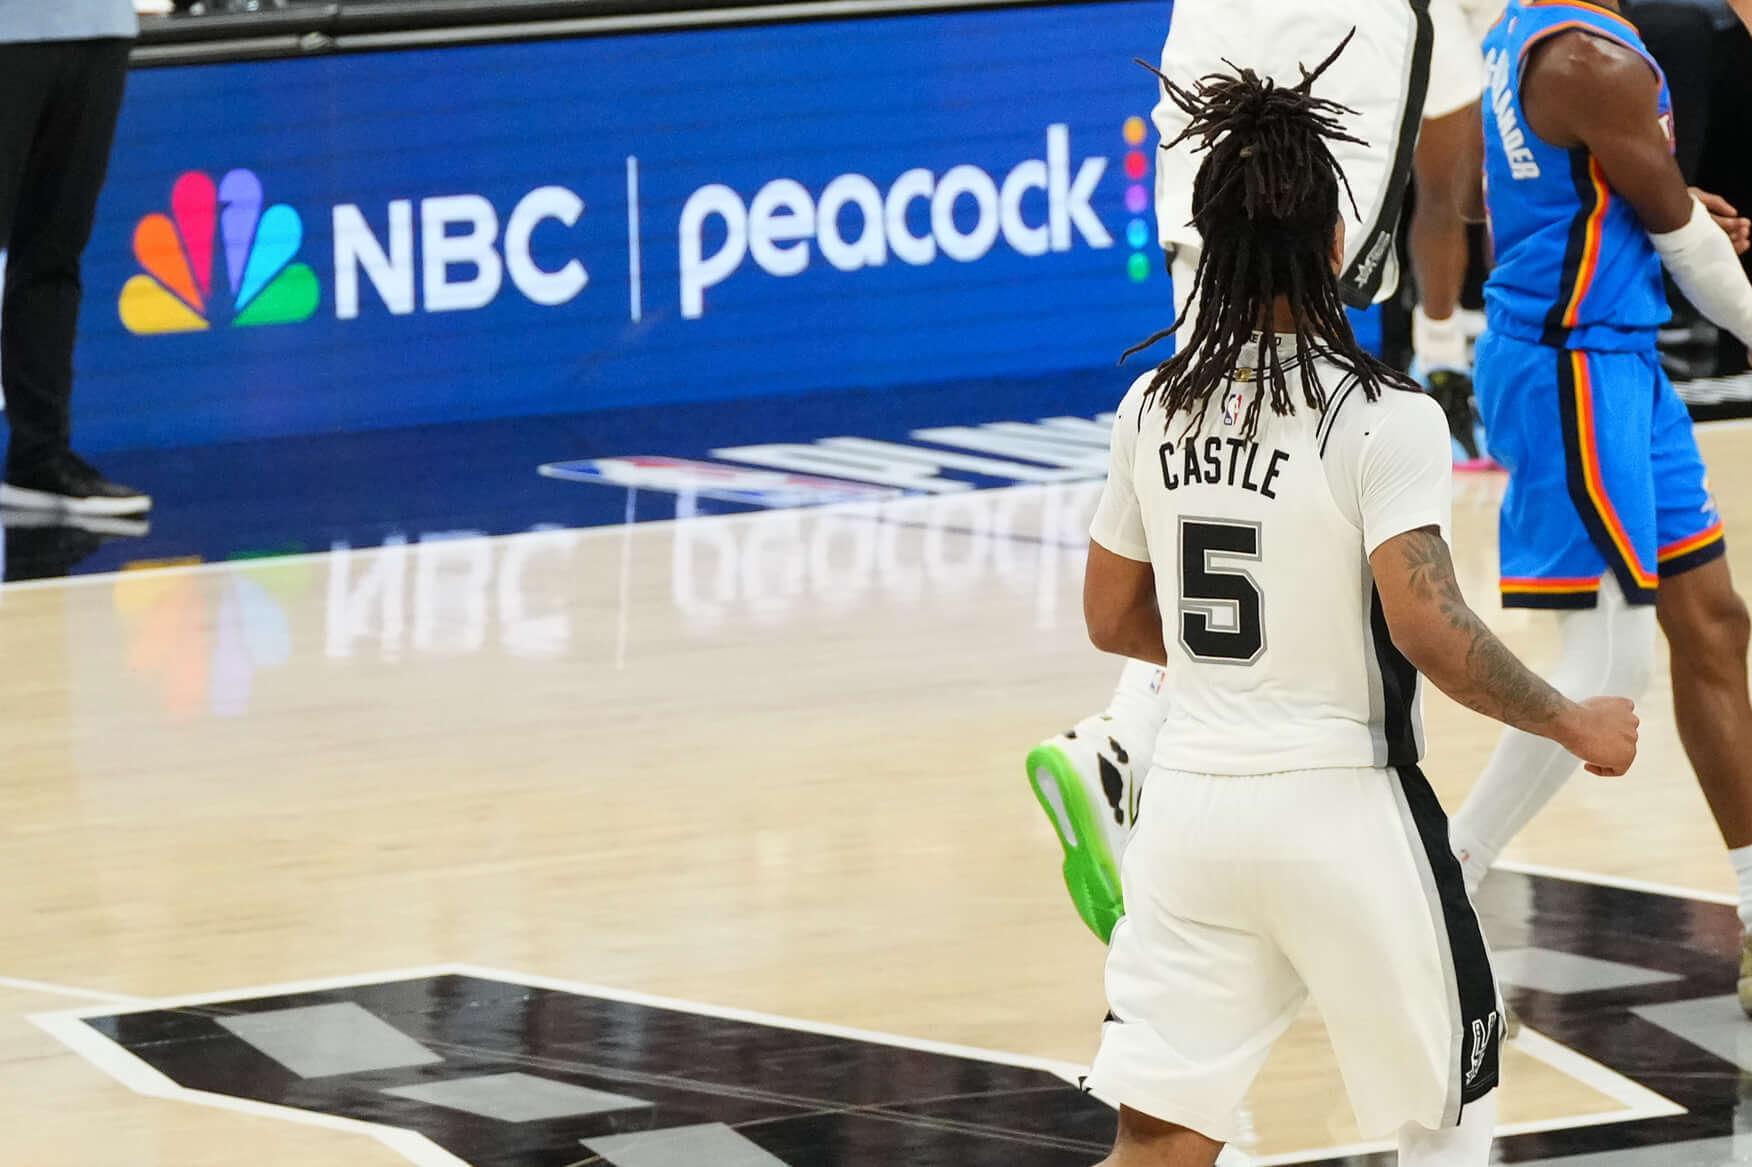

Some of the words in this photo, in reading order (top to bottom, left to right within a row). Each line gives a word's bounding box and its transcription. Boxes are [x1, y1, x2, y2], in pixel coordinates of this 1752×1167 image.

[332, 185, 590, 320] NBC
[679, 123, 1114, 320] peacock
[1159, 436, 1290, 500] CASTLE
[1177, 514, 1268, 666] 5
